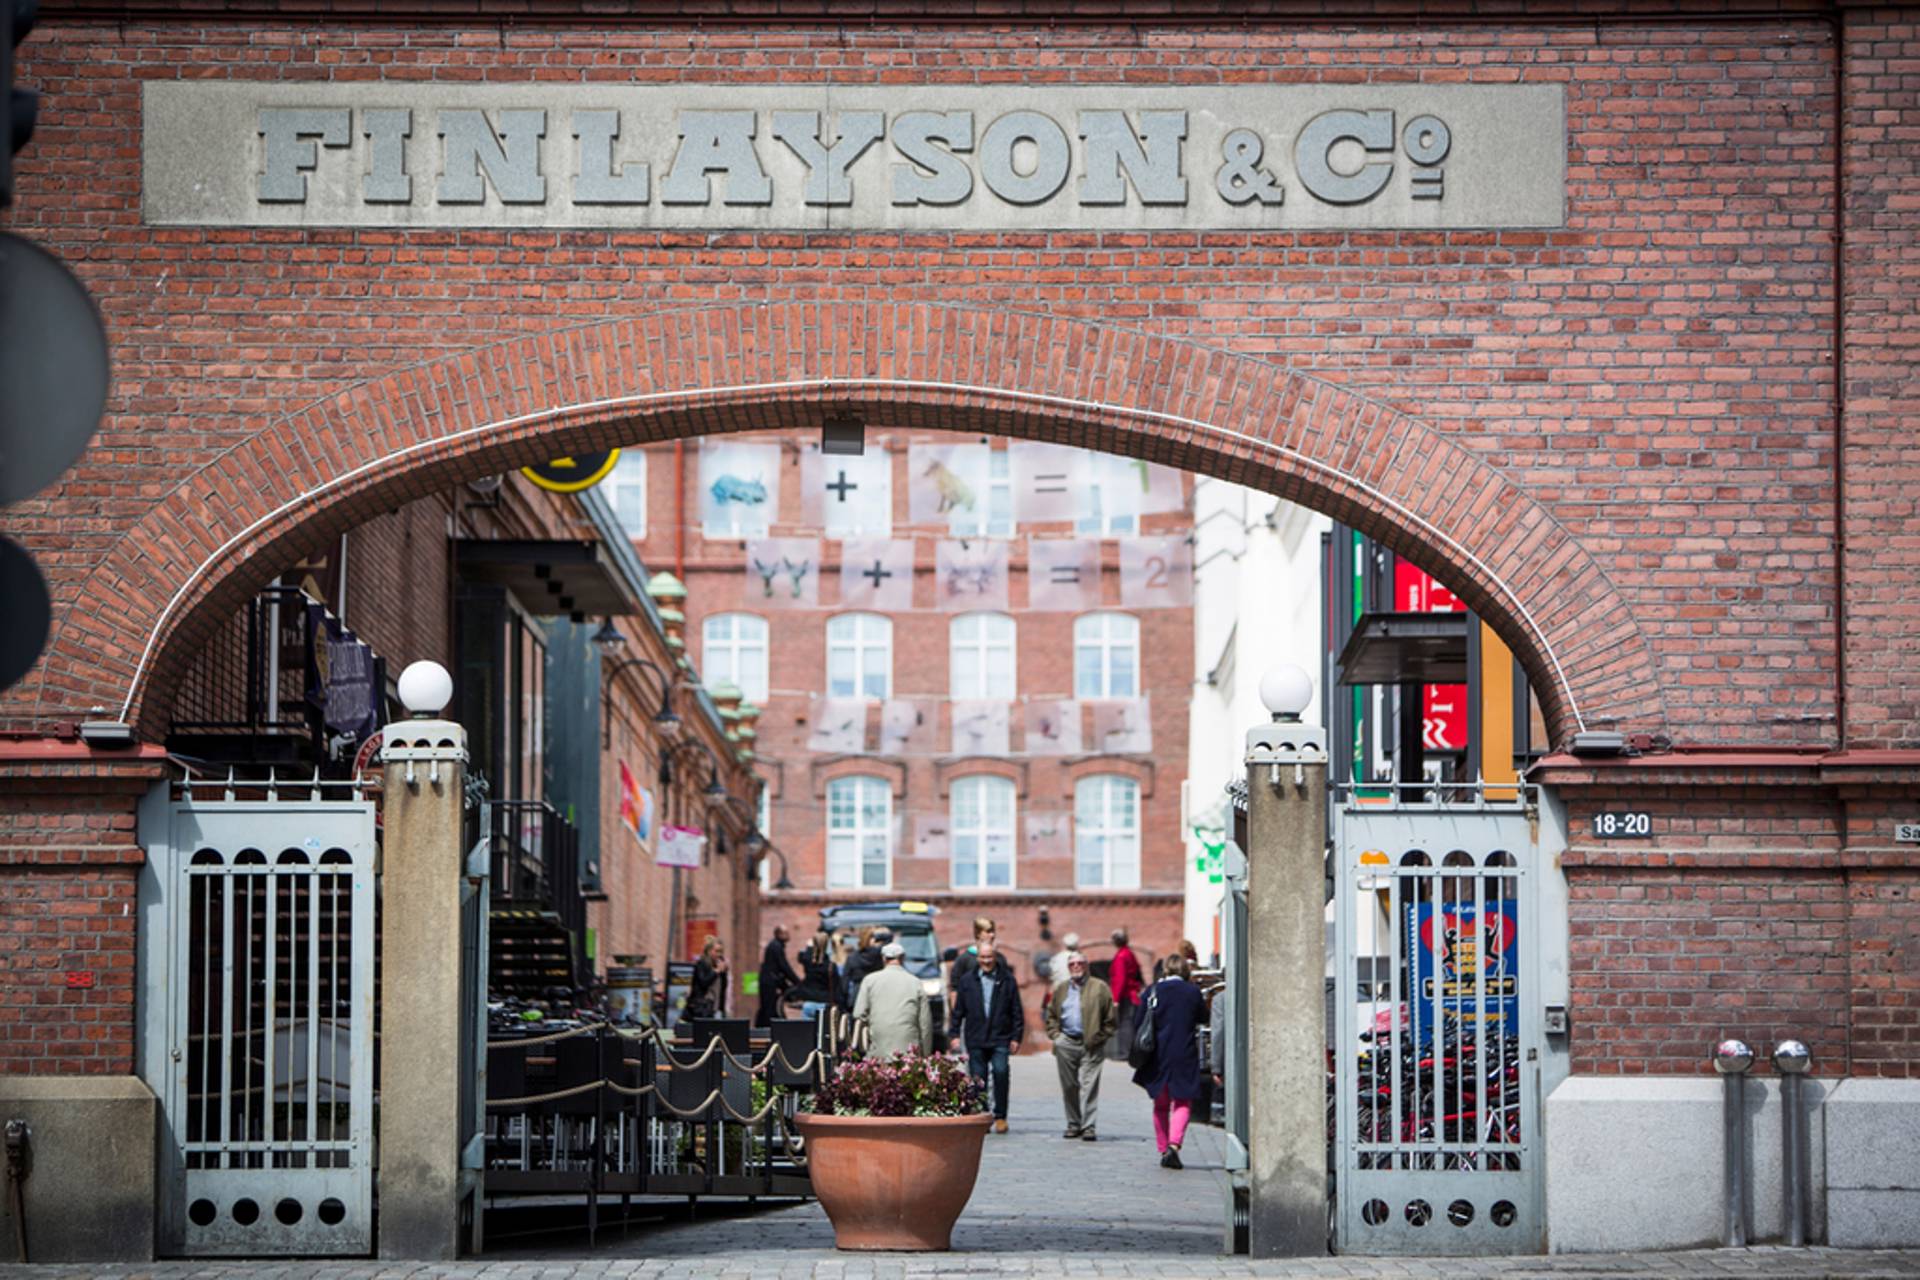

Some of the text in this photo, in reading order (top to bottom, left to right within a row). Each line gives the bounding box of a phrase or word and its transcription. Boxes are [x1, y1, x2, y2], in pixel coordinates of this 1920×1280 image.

[257, 107, 1189, 207] FINLAYSON
[1216, 127, 1285, 207] &
[1144, 555, 1168, 589] 2
[1594, 813, 1649, 834] 18-20
